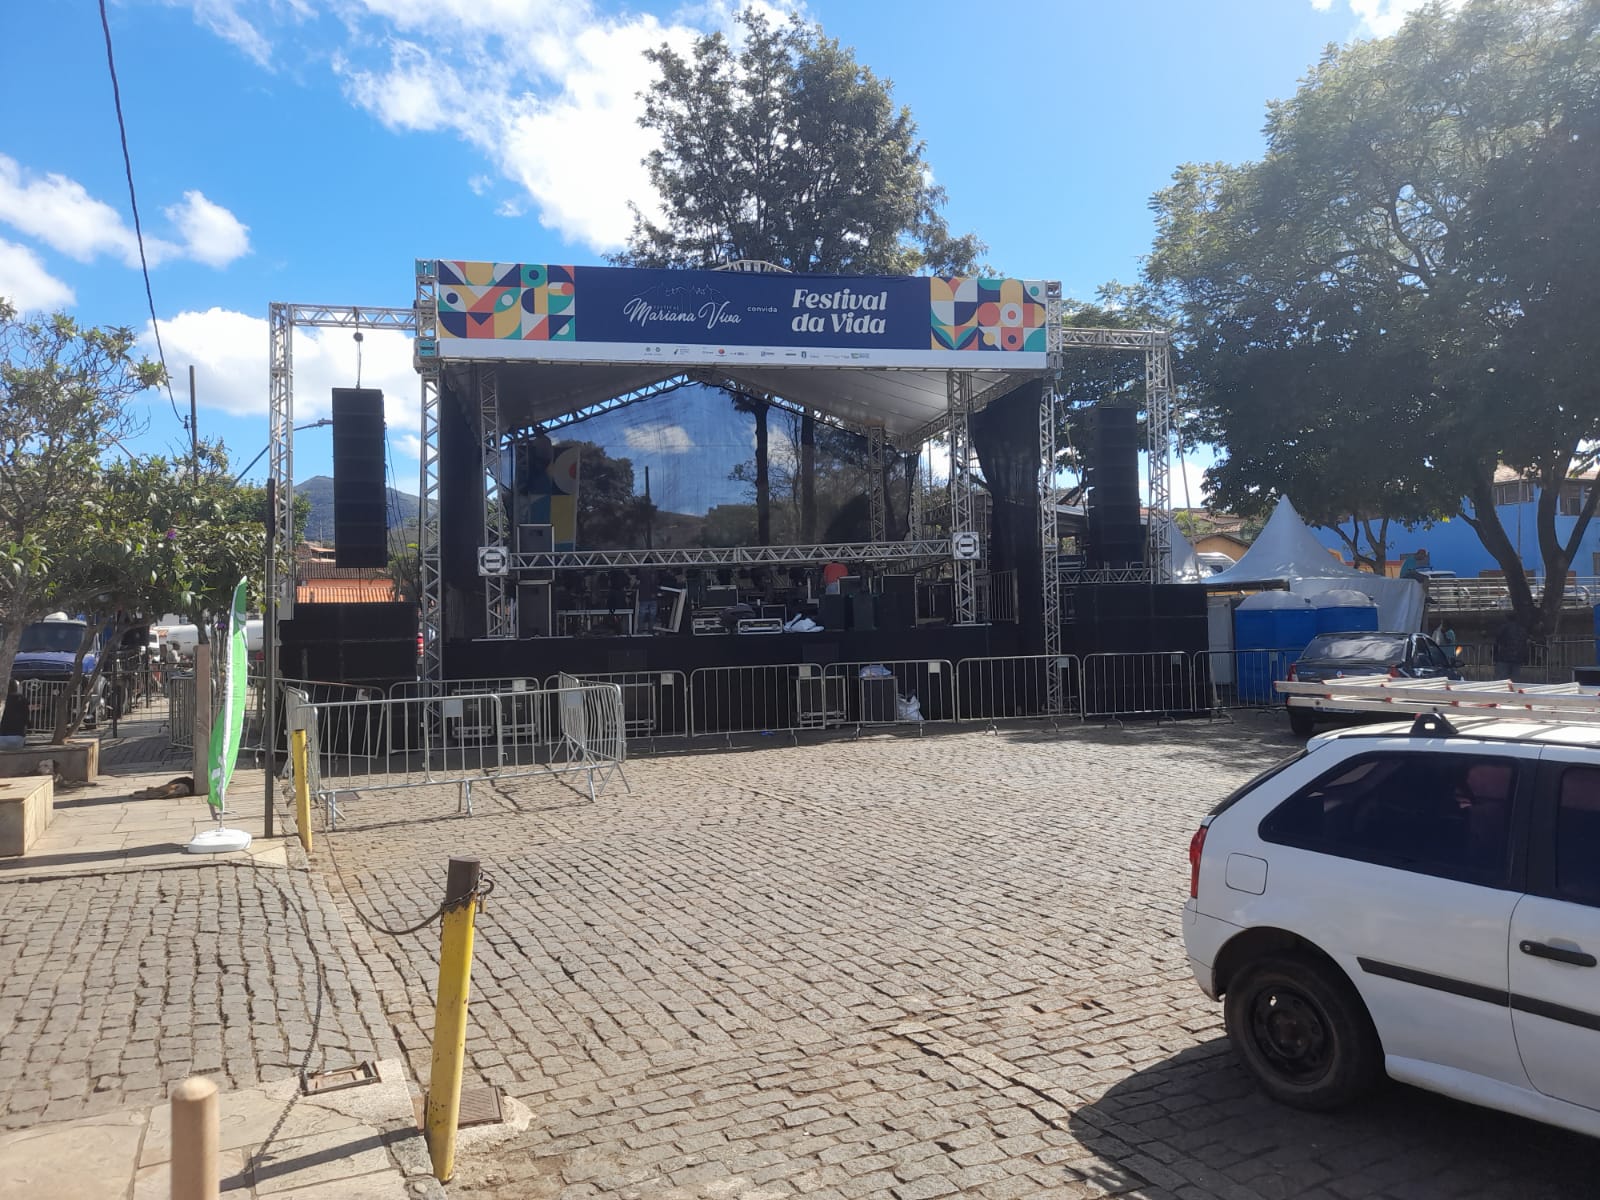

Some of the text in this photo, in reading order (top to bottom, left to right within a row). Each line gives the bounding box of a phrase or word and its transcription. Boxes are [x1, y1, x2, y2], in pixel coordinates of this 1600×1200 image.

[791, 288, 888, 312] Festival
[623, 297, 778, 329] Mariana Viva convida
[791, 312, 887, 335] da Vida
